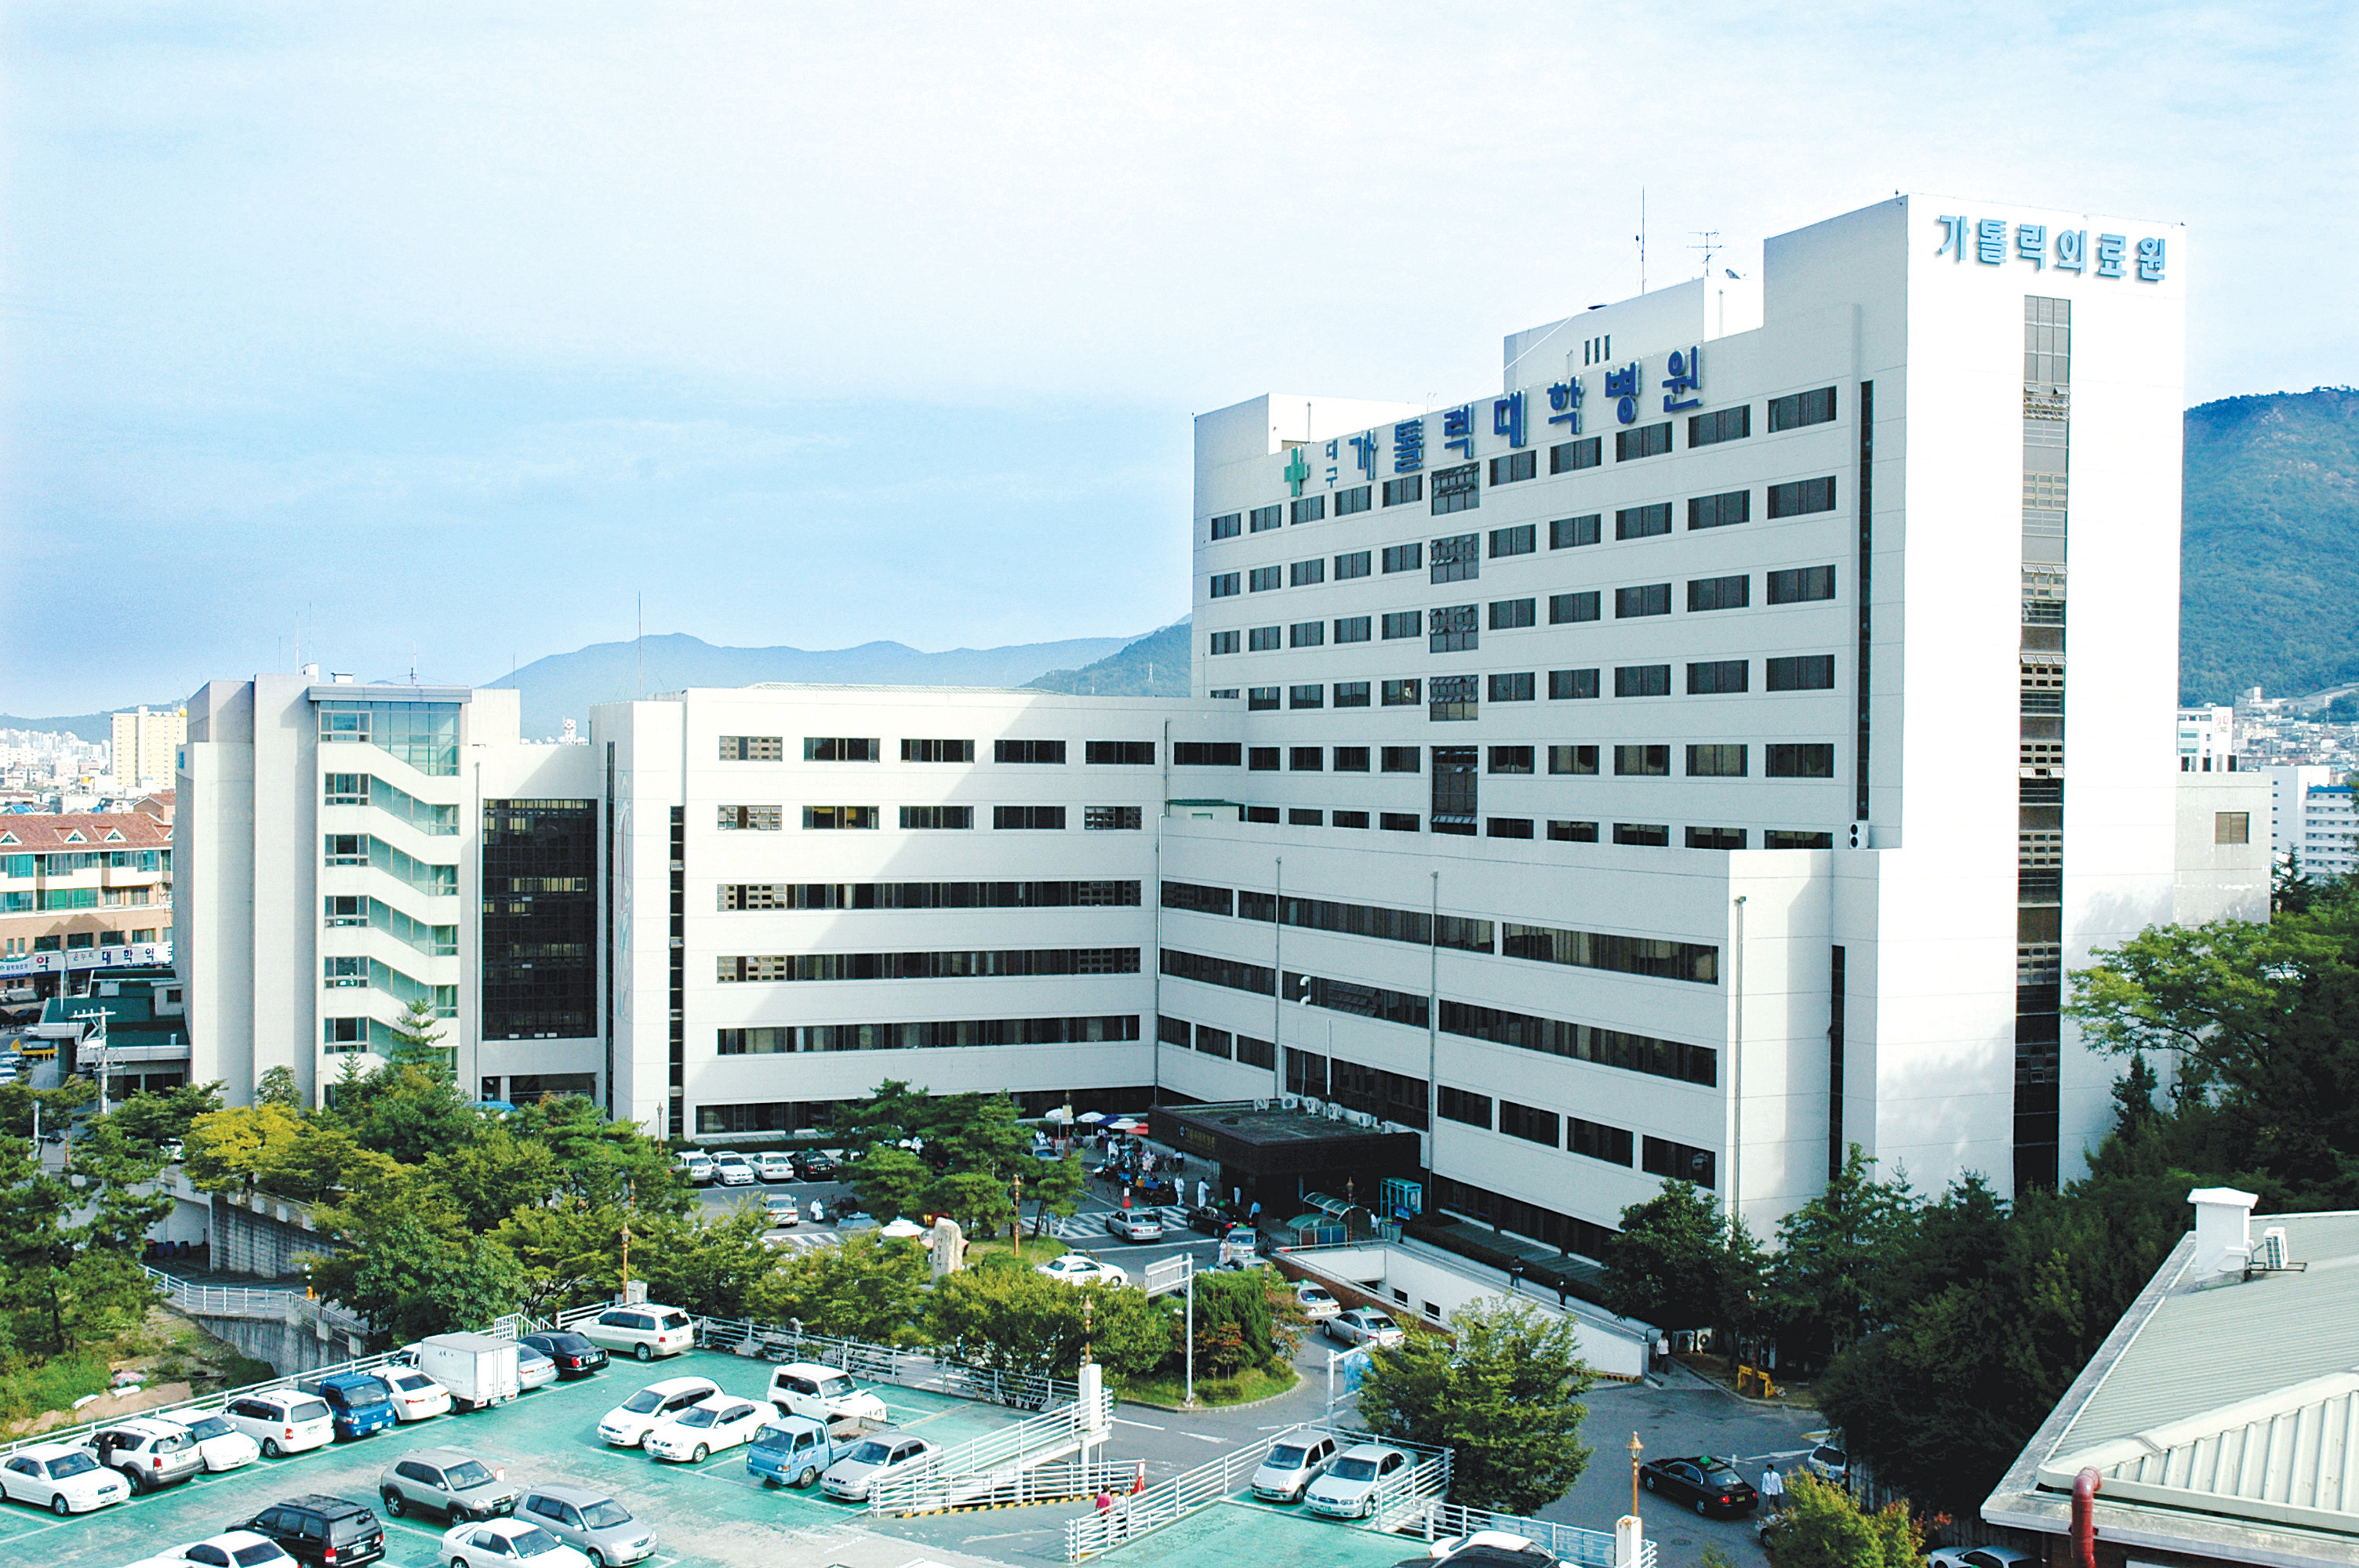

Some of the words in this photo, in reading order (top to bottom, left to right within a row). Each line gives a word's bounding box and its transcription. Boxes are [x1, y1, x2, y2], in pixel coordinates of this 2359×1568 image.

[1938, 215, 2165, 281] 가톨릭의료원
[1349, 346, 1703, 481] 가톨릭대학병원
[36, 956, 49, 971] 약
